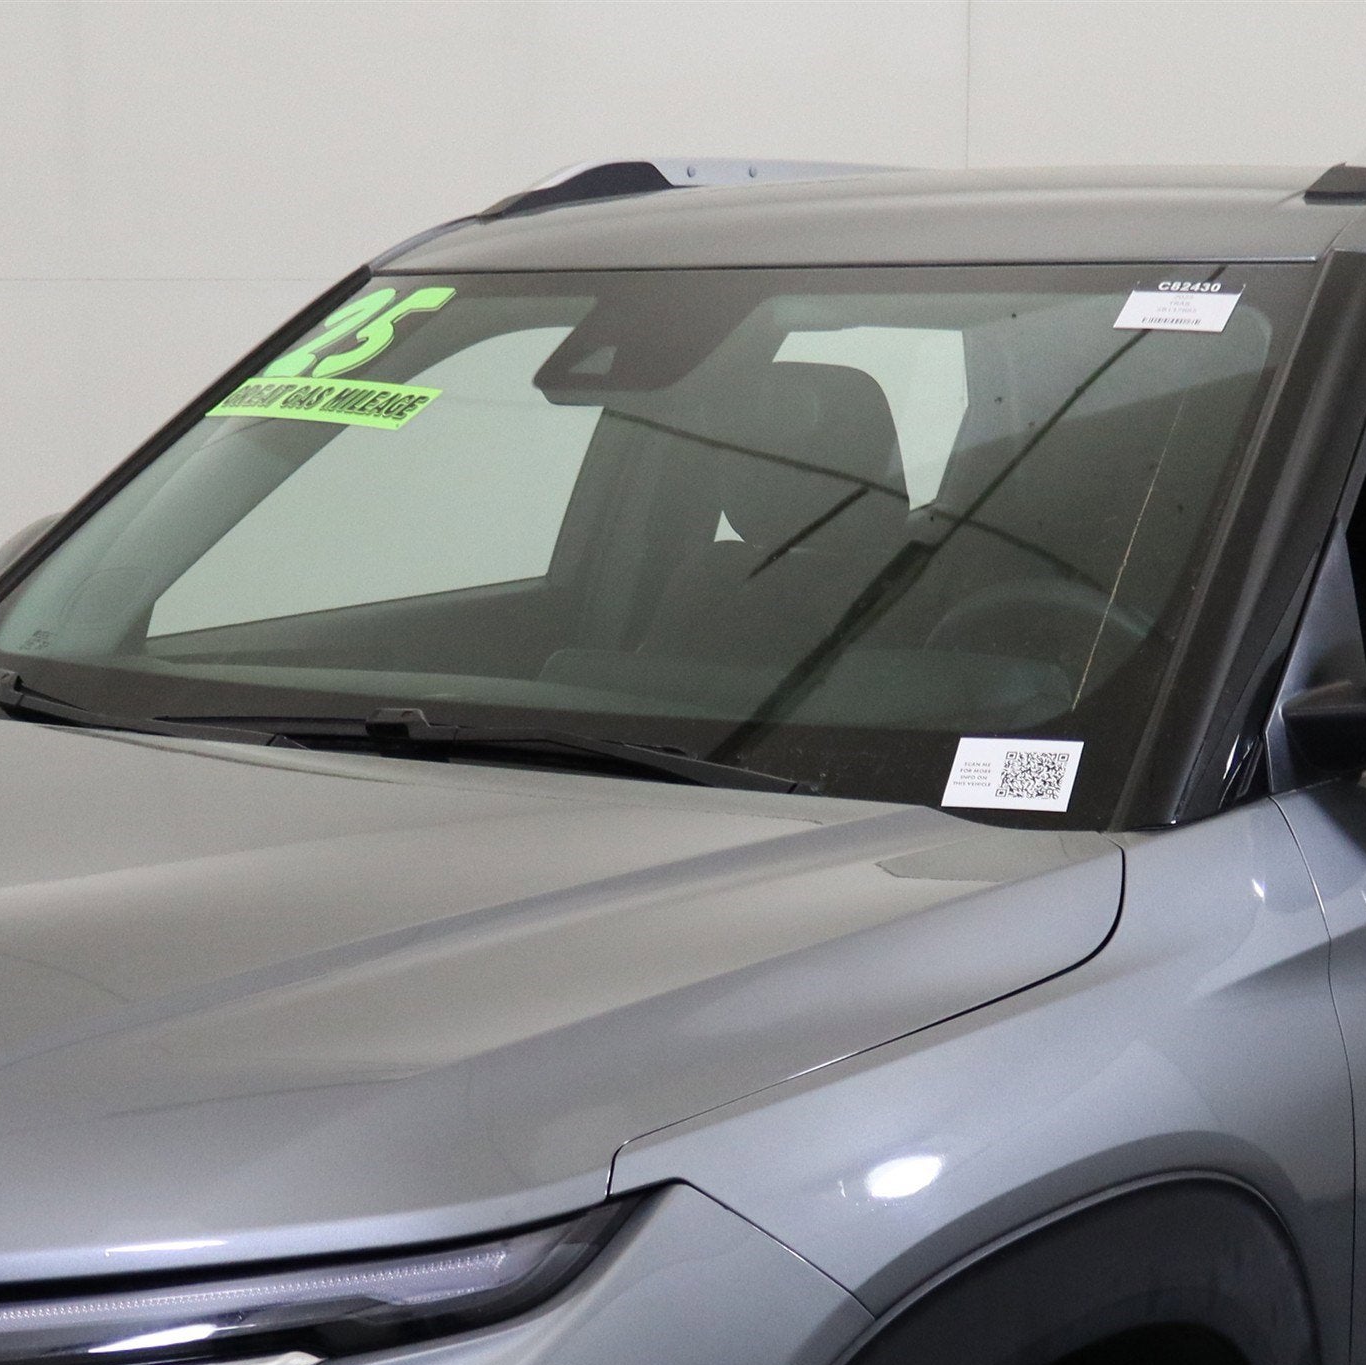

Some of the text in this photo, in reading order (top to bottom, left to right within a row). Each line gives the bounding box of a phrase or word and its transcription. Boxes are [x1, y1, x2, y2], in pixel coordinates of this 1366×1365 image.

[261, 286, 458, 378] 25
[279, 384, 336, 411] GAS
[319, 387, 431, 420] MILEAGE
